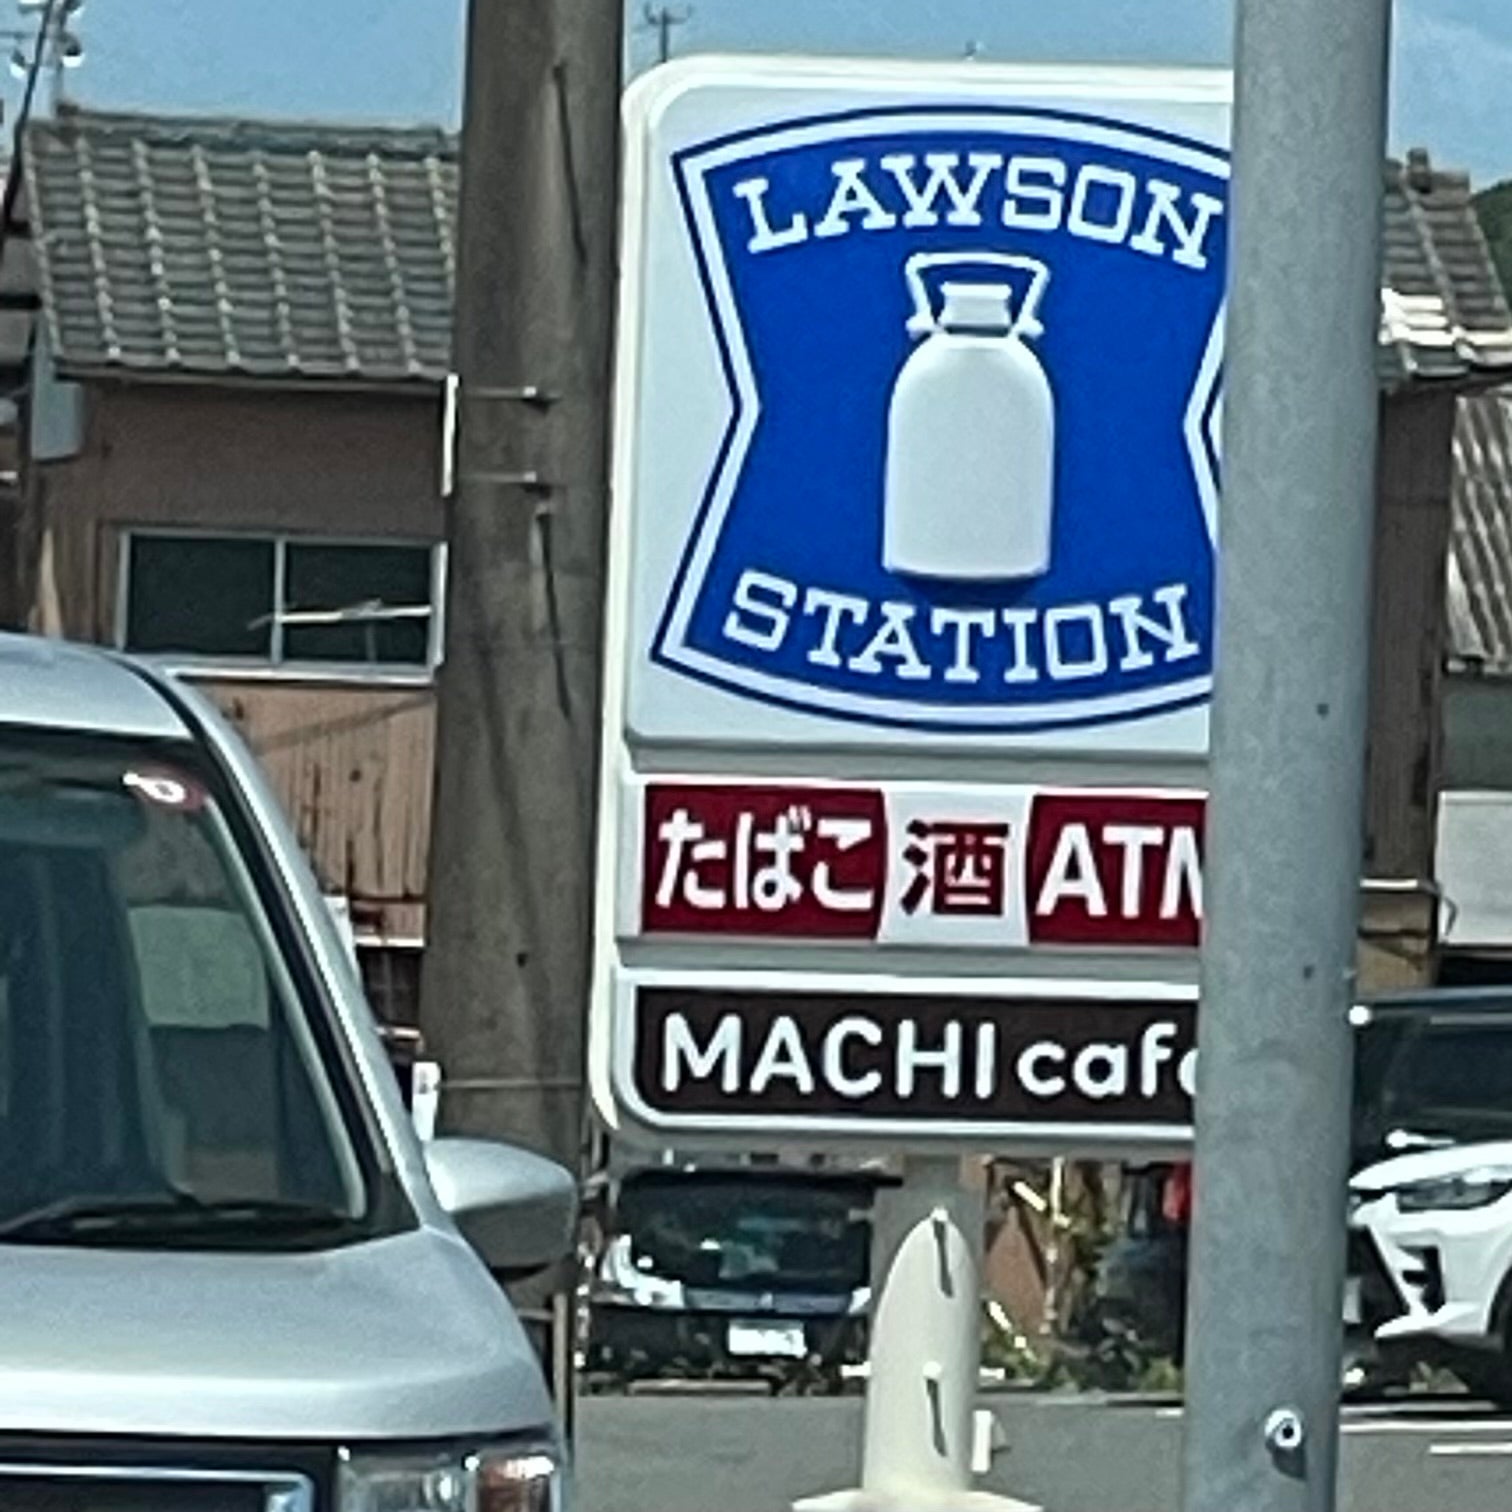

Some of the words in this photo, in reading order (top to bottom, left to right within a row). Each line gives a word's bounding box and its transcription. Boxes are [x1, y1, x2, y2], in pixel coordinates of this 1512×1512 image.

[734, 153, 1223, 269] LAWSON
[722, 568, 1200, 683] STATION
[655, 804, 874, 910] たばこ
[899, 818, 1009, 916] 酒
[663, 1012, 995, 1099] MACHI
